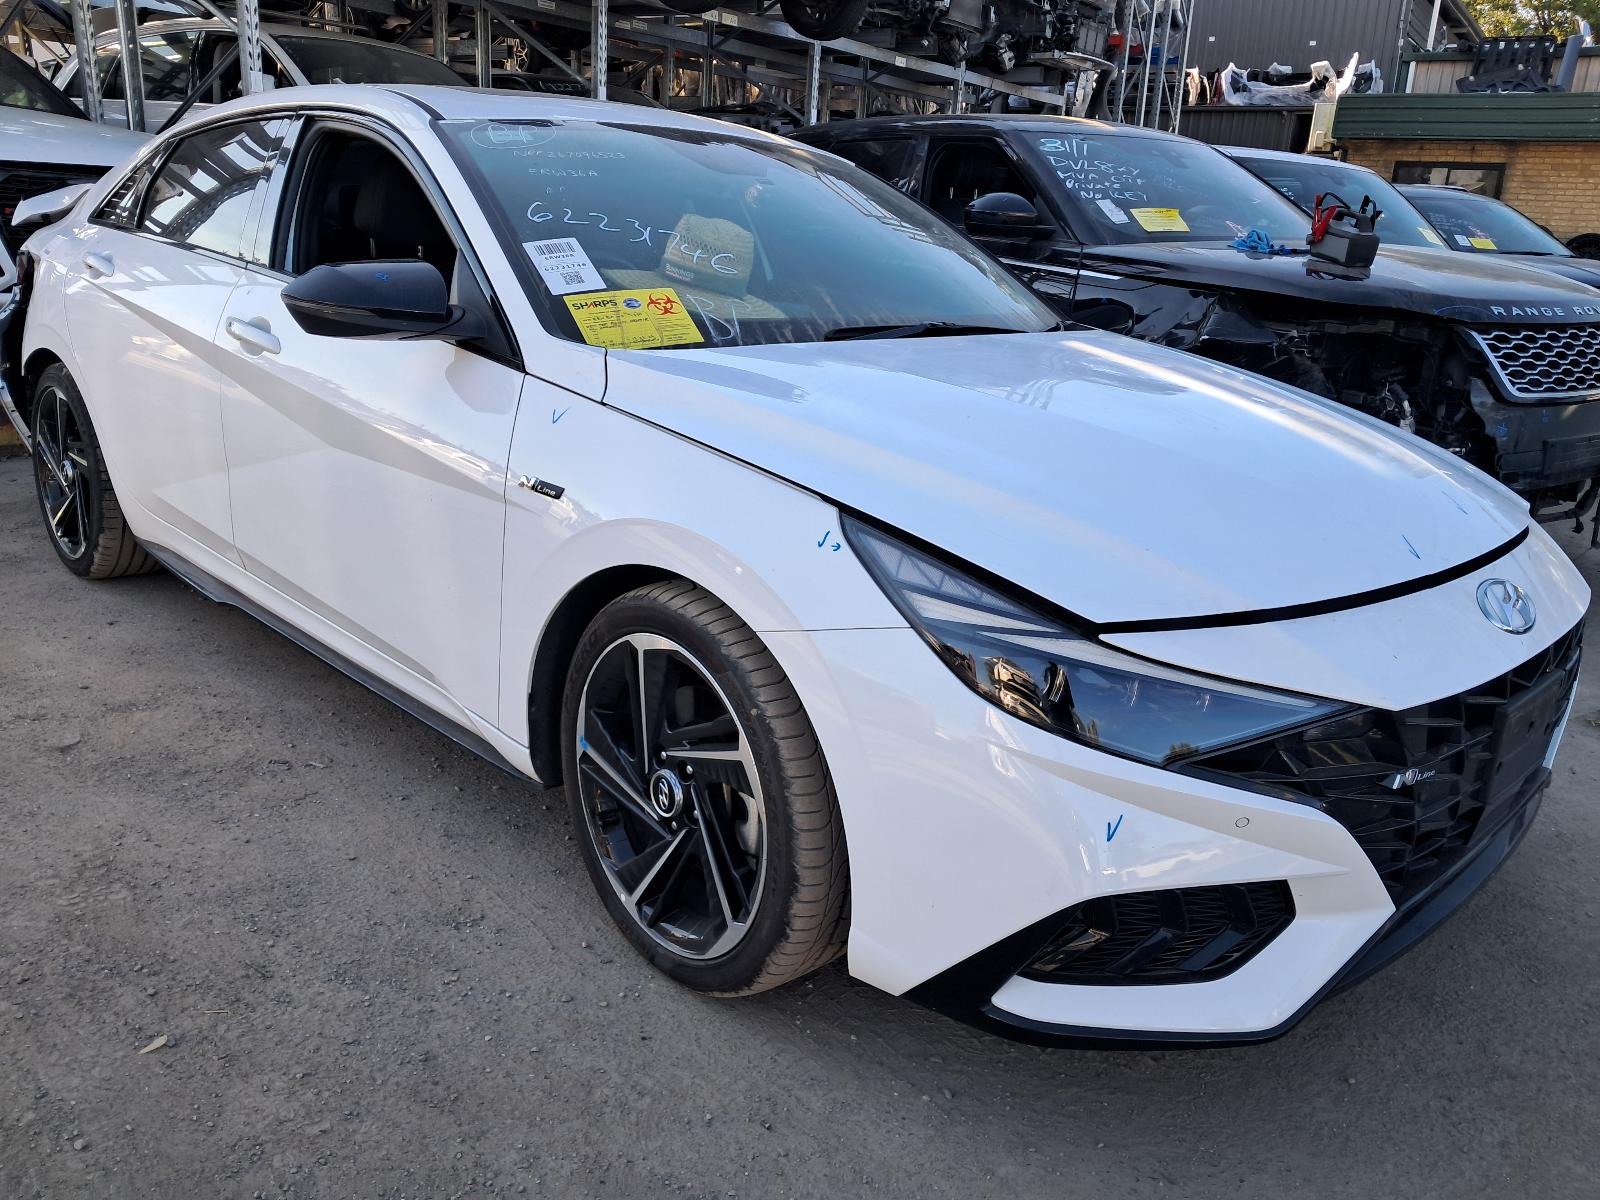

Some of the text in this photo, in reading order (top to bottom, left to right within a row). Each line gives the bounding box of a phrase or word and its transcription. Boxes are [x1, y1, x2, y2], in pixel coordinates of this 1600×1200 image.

[571, 300, 618, 311] SHARPS
[1490, 305, 1566, 316] RANGE
[537, 484, 556, 496] Line
[1417, 770, 1436, 780] Line
